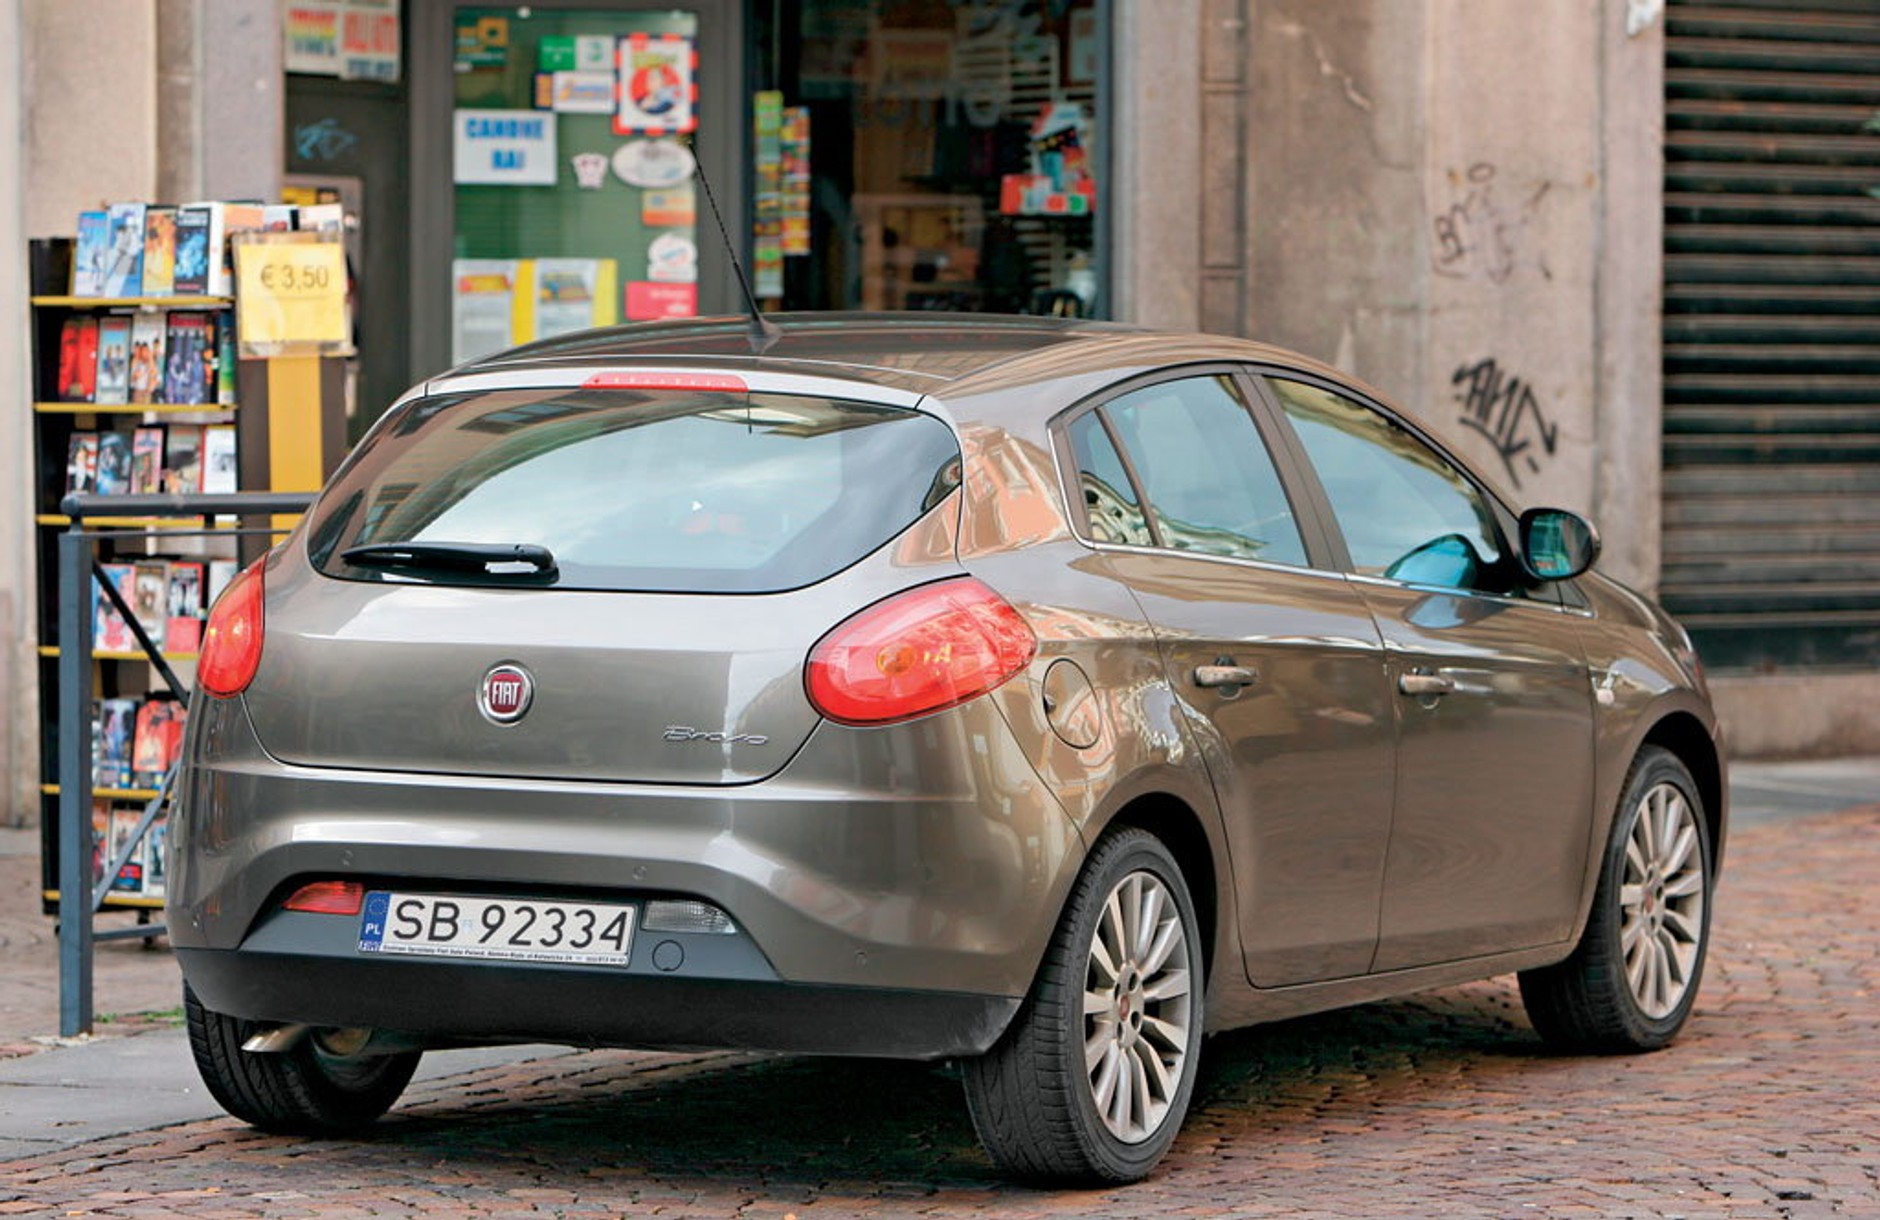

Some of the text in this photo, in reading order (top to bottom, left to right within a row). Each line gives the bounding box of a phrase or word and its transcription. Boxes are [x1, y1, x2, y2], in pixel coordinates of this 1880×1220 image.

[260, 264, 329, 292] € 3,50
[491, 682, 520, 706] FIAT
[663, 726, 769, 745] Bravo
[365, 922, 381, 935] PL
[393, 900, 629, 951] SB 92334
